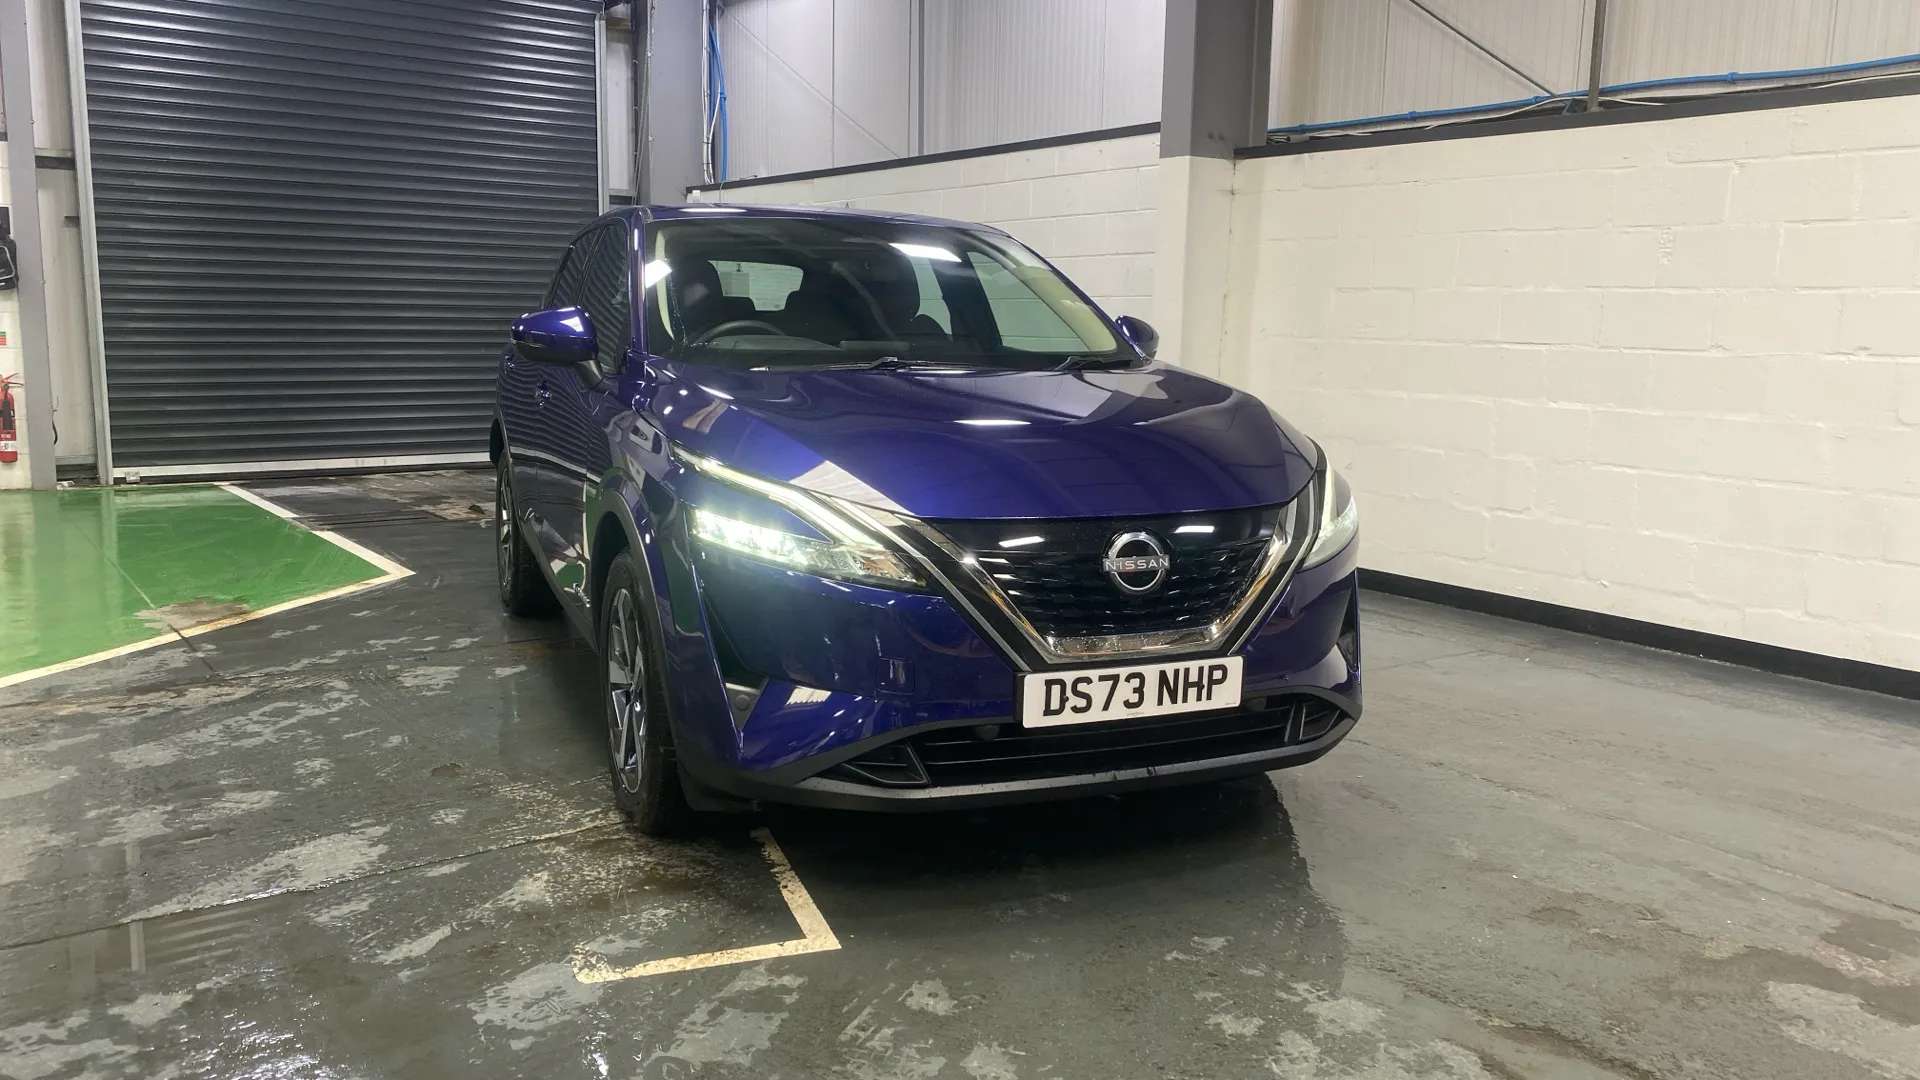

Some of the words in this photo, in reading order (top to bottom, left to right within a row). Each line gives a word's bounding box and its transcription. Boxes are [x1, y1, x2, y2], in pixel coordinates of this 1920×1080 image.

[1105, 557, 1169, 570] NISSAN
[1043, 671, 1146, 717] DS73
[1156, 664, 1228, 707] NHP
